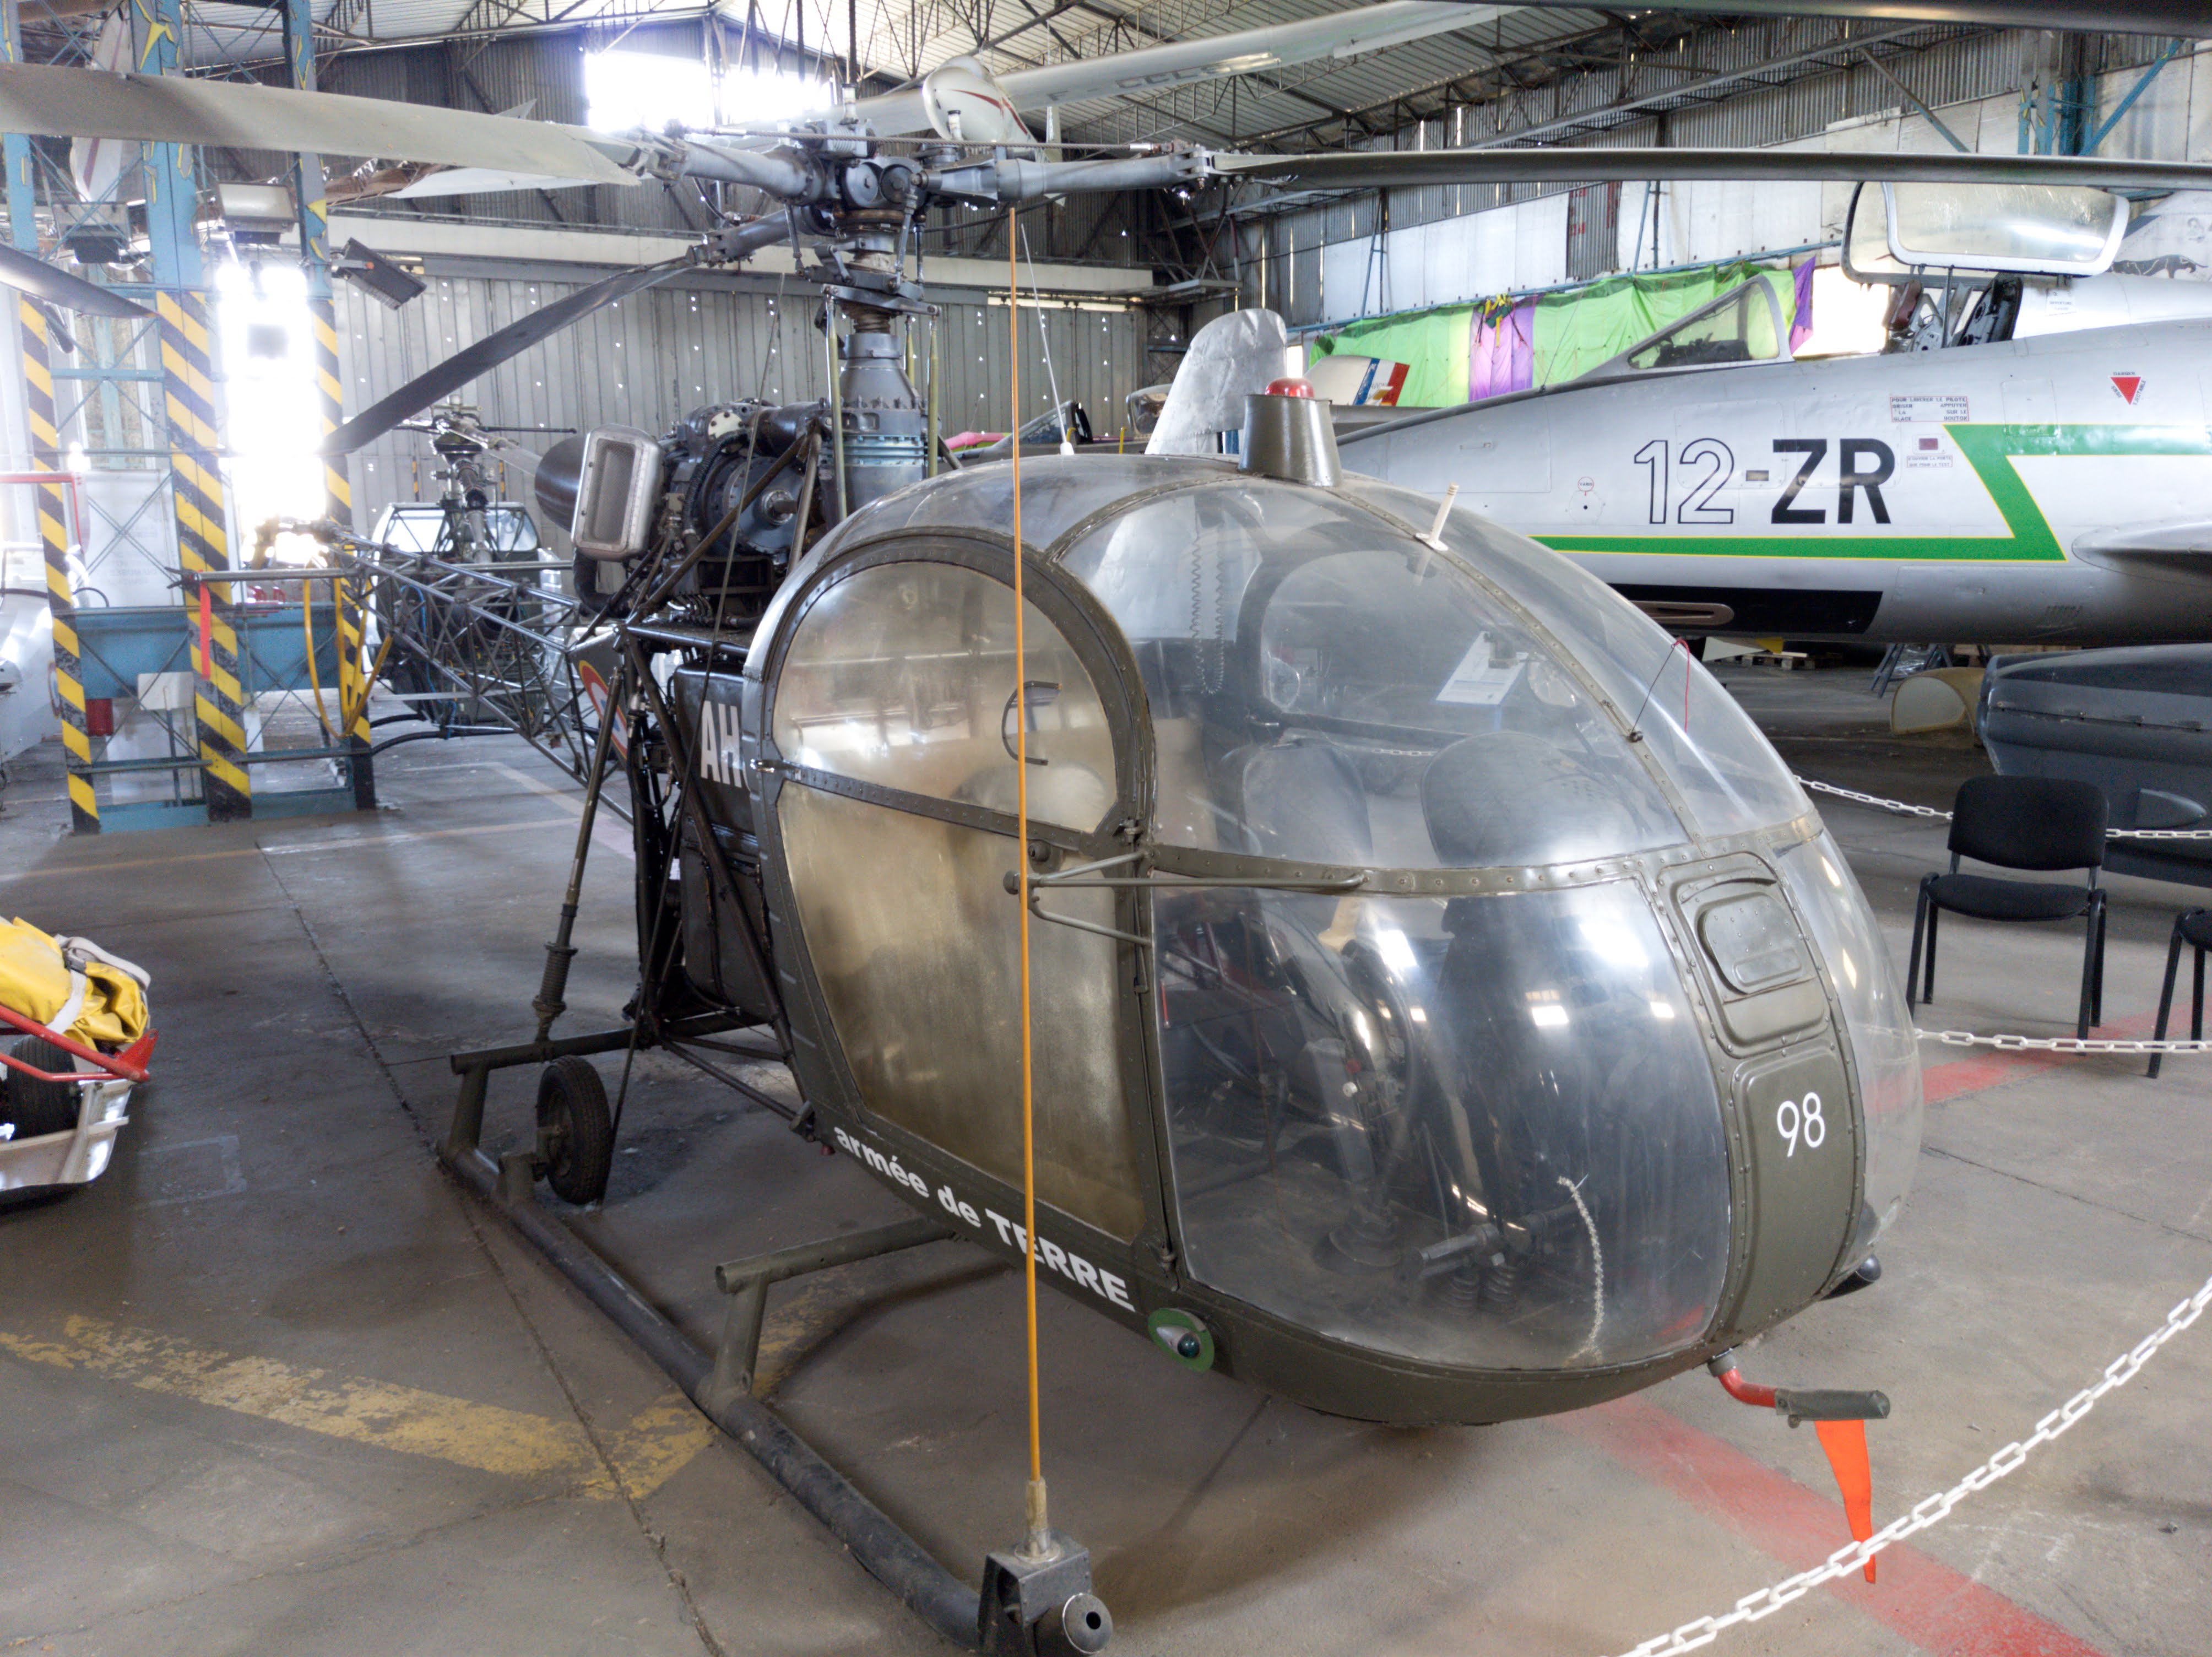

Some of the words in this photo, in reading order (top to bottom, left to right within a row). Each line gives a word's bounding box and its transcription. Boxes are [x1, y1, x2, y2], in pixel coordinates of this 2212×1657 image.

[1634, 438, 1895, 524] 12-ZR
[1777, 1092, 1825, 1157] 98
[834, 1127, 929, 1198] armée
[937, 1185, 982, 1228] de
[985, 1208, 1136, 1313] TERRE
